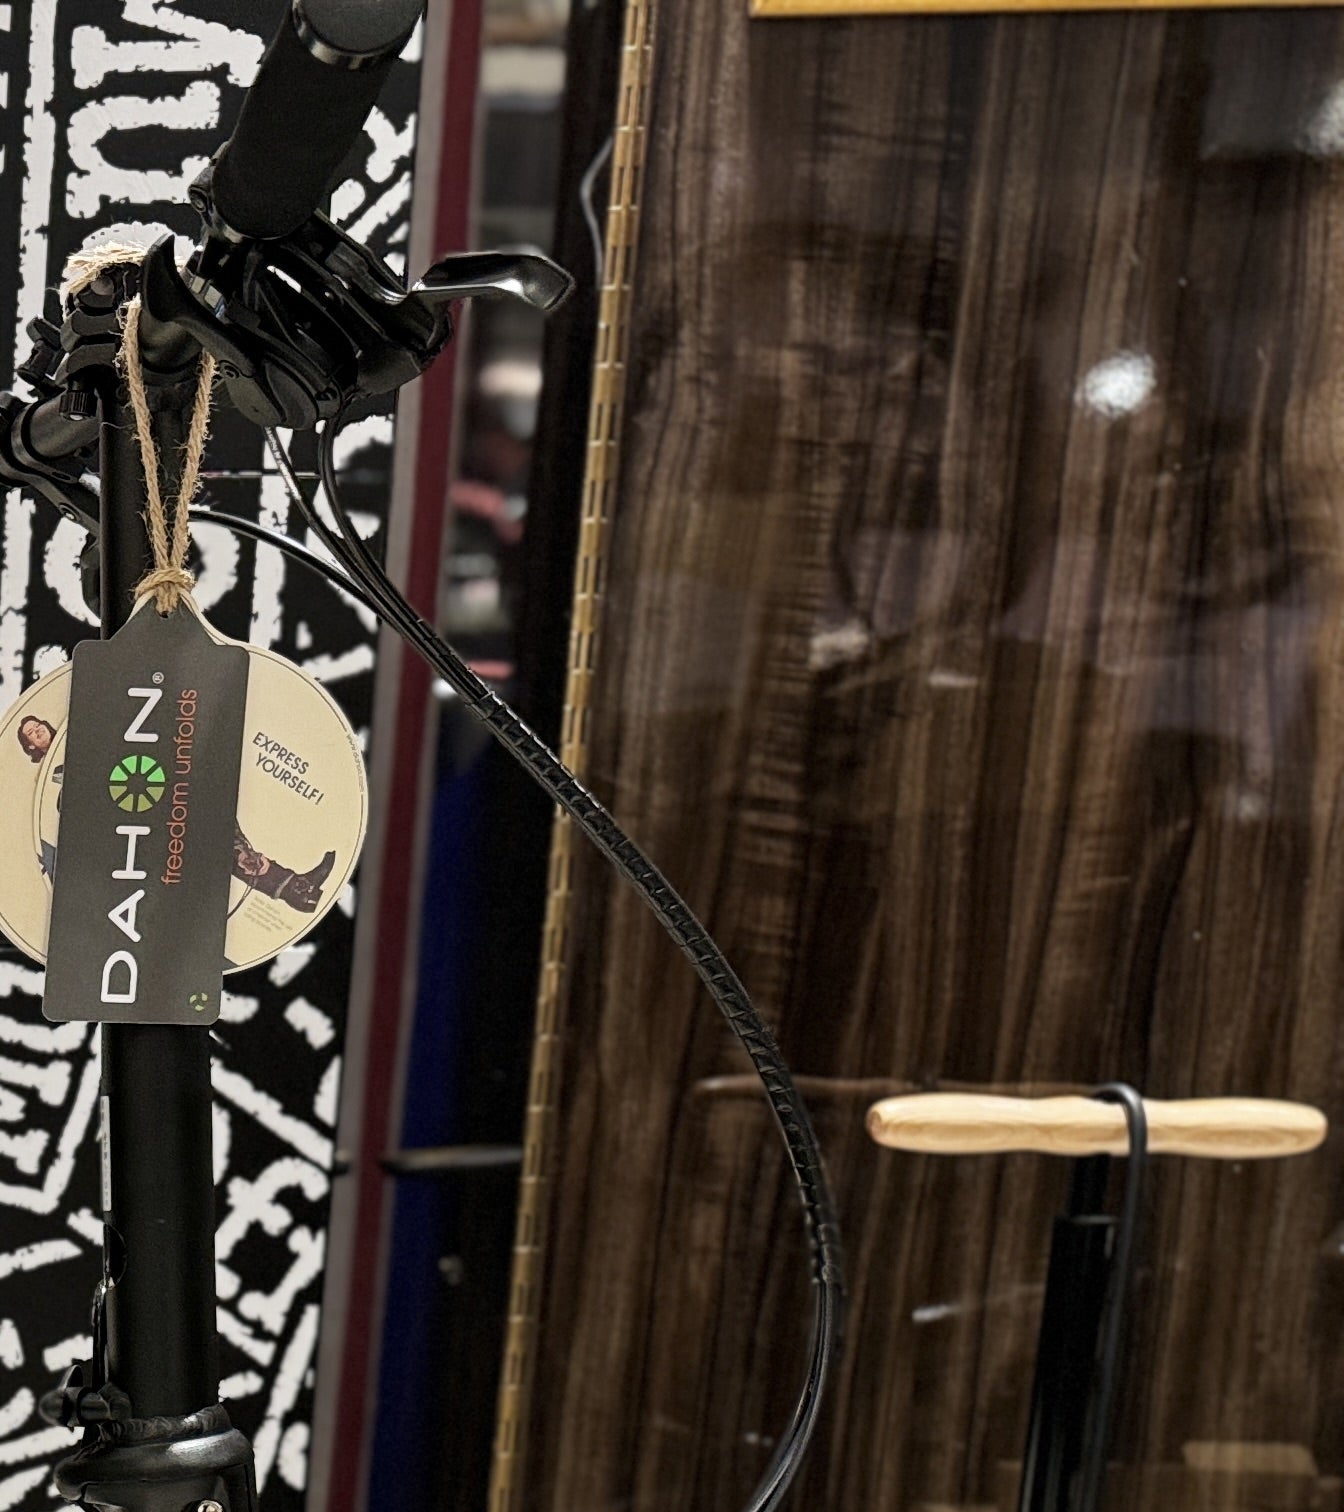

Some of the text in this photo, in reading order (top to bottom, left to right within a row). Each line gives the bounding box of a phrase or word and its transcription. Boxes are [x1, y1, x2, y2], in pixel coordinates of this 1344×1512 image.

[252, 731, 310, 775] EXPRESS
[161, 689, 198, 886] freedom unfolds
[255, 754, 325, 806] YOURSELF!
